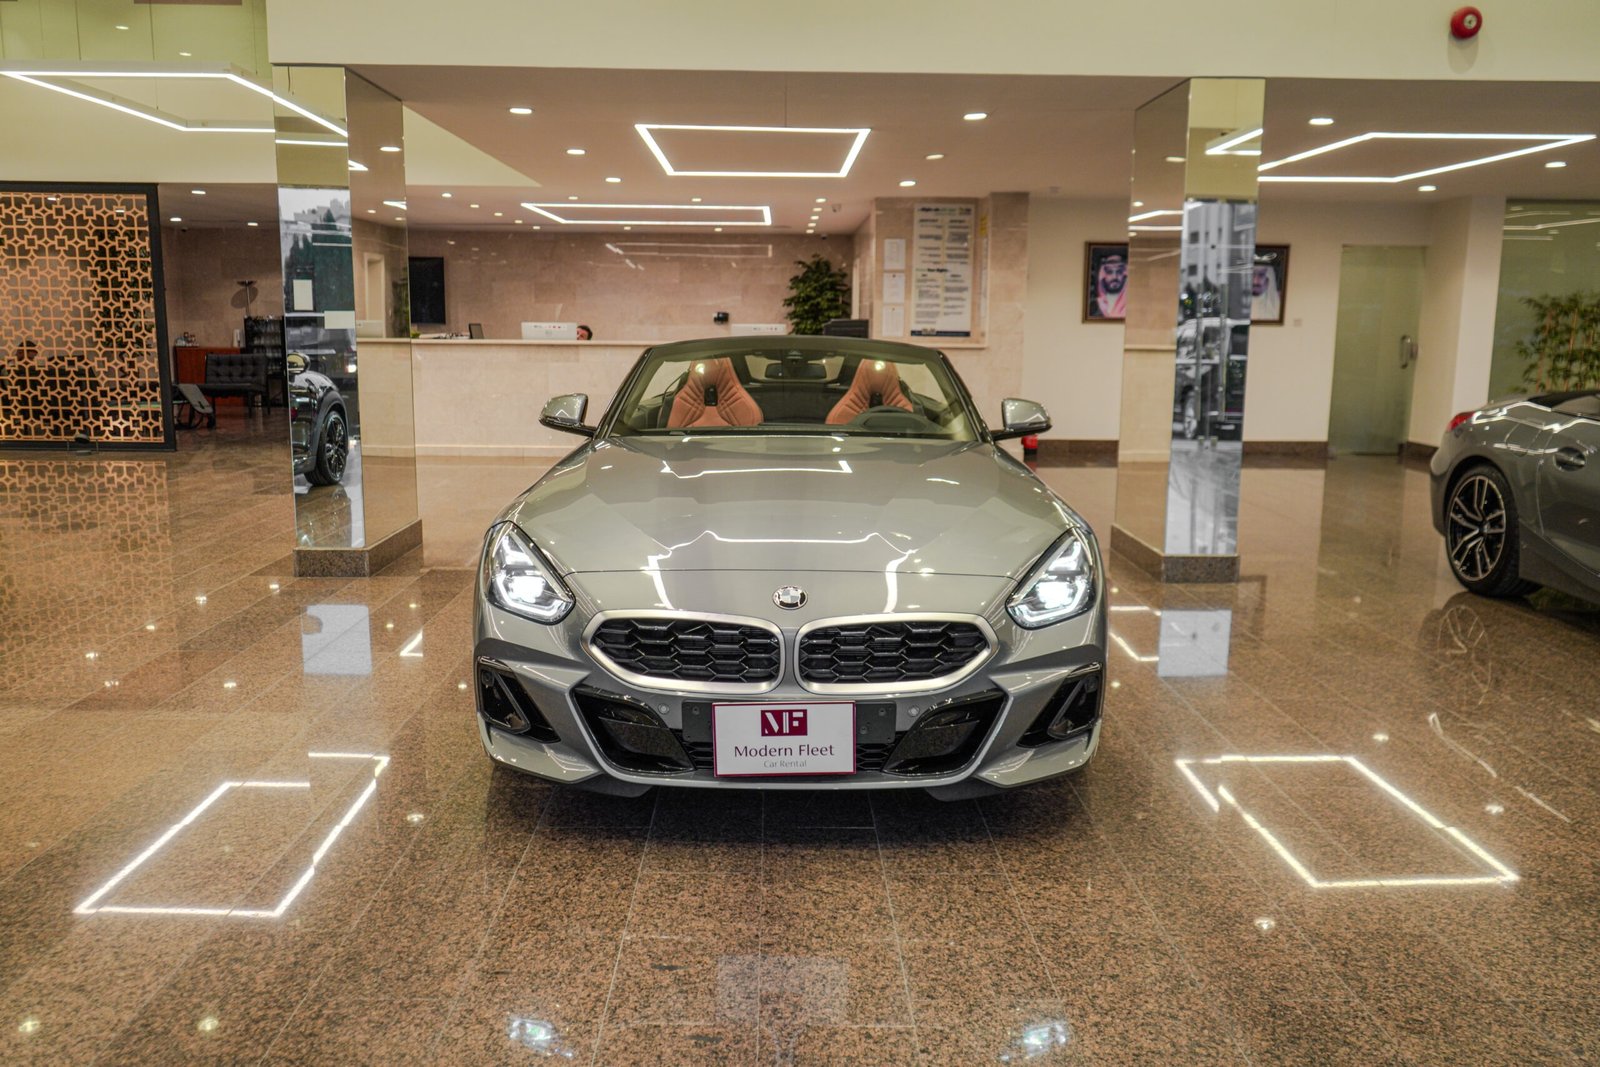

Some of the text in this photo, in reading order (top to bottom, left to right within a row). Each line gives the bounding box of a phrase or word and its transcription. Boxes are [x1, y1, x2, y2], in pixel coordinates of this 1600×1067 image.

[734, 744, 835, 757] Modern Fleet
[763, 759, 807, 768] Car Rental
